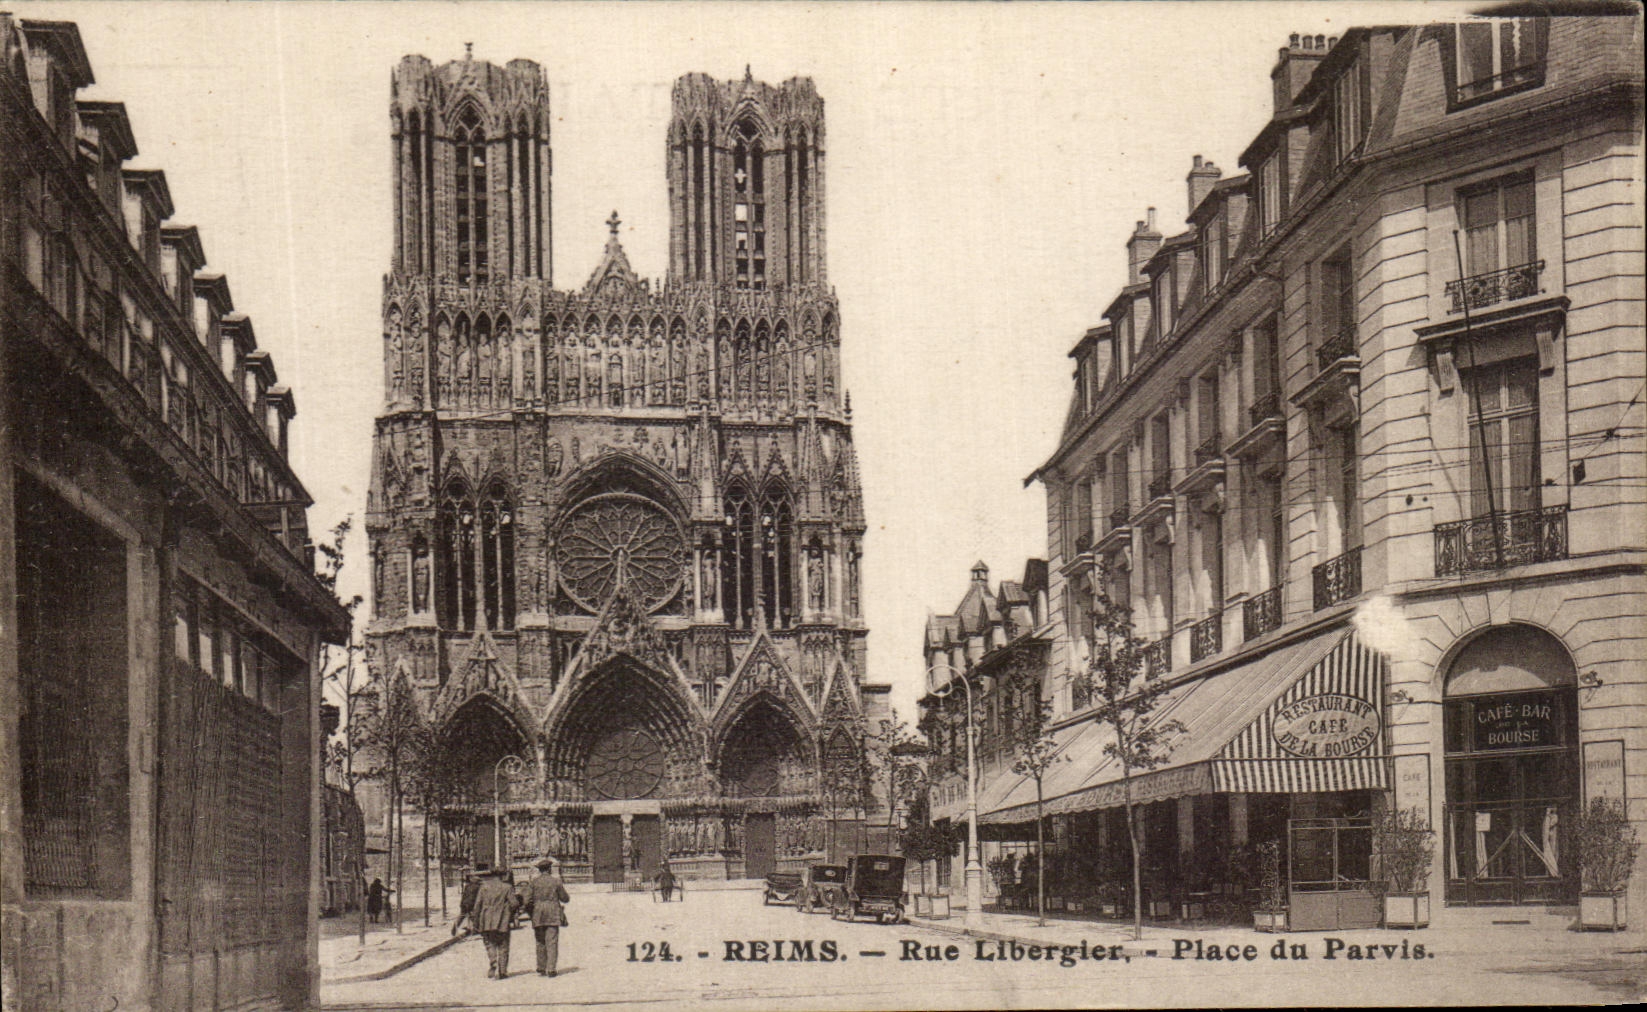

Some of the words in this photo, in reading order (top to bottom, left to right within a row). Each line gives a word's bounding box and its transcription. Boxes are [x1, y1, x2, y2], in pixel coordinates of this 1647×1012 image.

[1281, 696, 1372, 724] RESTAURANT
[1521, 704, 1552, 720] BAR
[1308, 719, 1348, 735] CAFE
[1279, 731, 1300, 750] DE
[1300, 740, 1318, 757] LA
[1325, 727, 1375, 757] BOURSE
[1488, 730, 1540, 745] BOURSE
